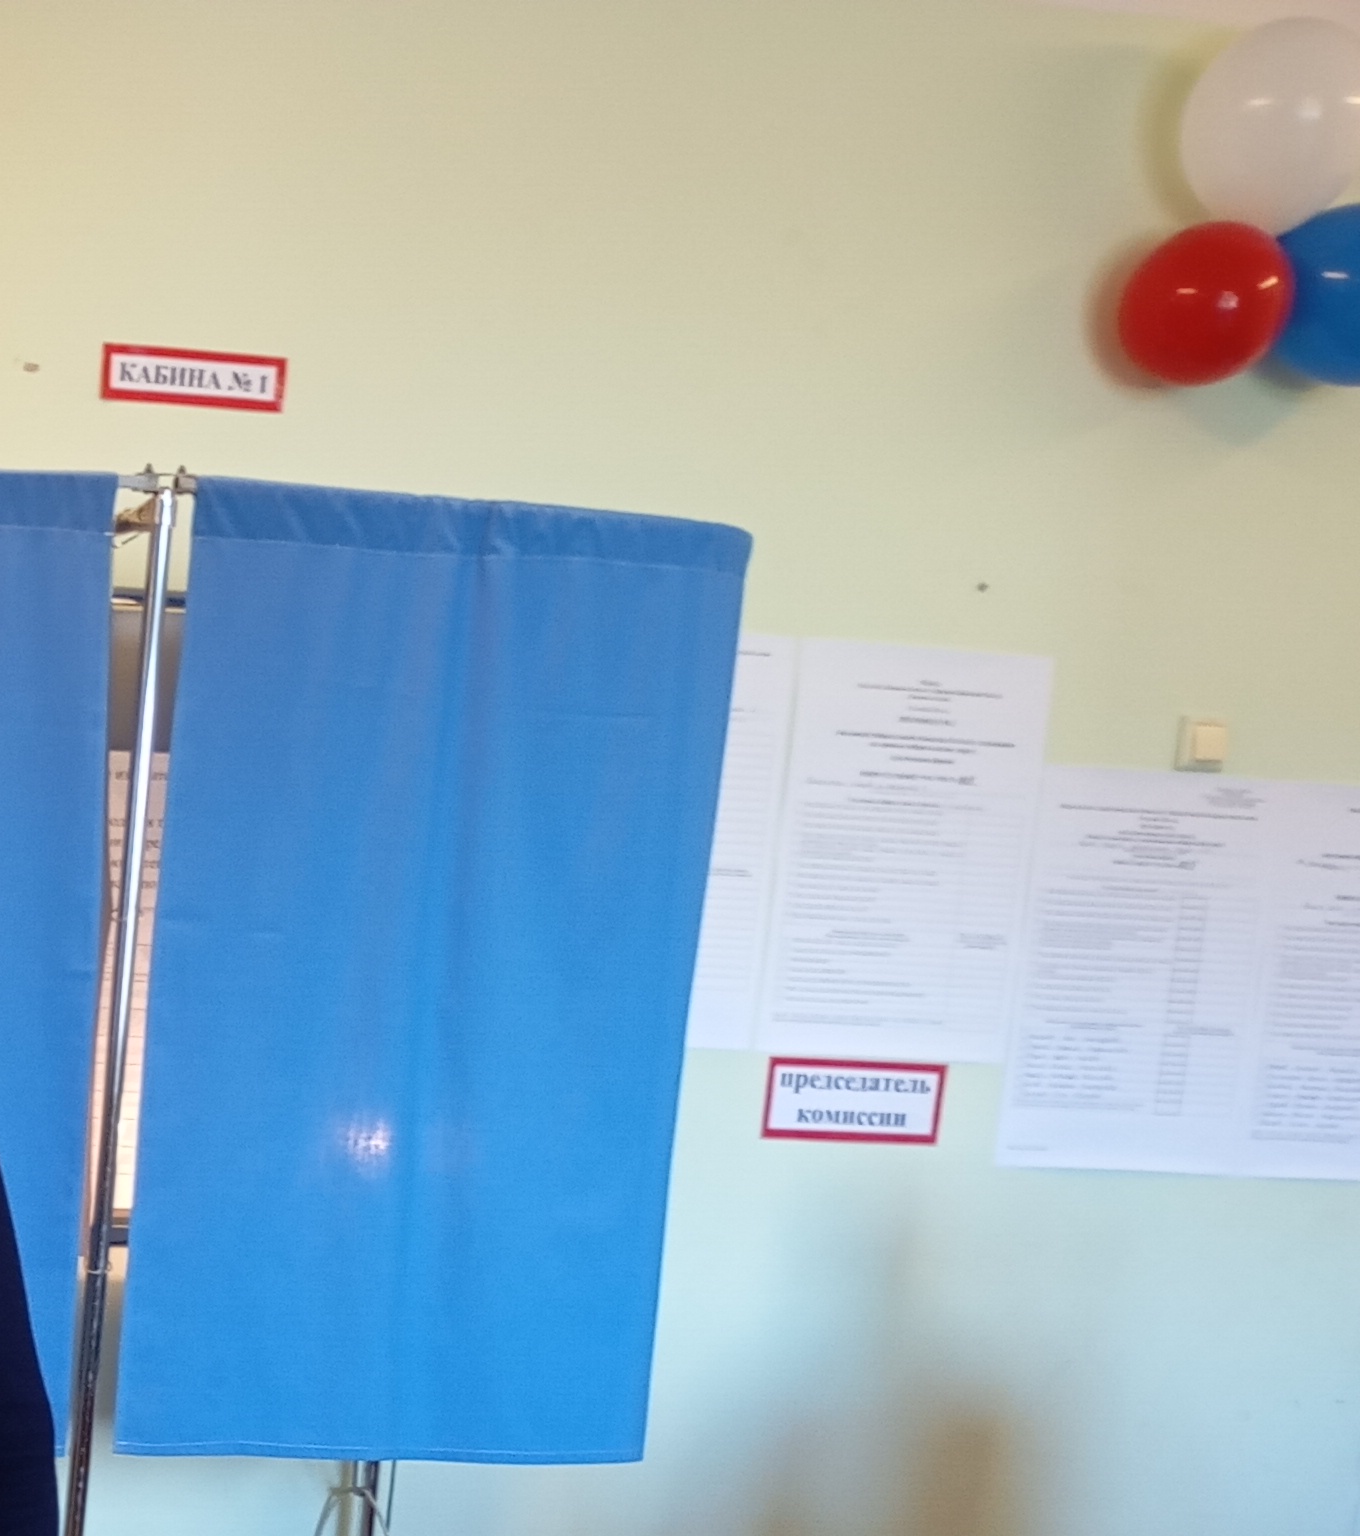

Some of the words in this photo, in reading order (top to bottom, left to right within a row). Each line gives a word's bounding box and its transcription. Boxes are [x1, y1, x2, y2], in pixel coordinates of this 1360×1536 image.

[119, 361, 223, 391] КАБИНА
[227, 370, 253, 393] №
[259, 375, 269, 394] 1
[780, 1071, 932, 1095] председатель
[796, 1107, 908, 1128] комиссии
